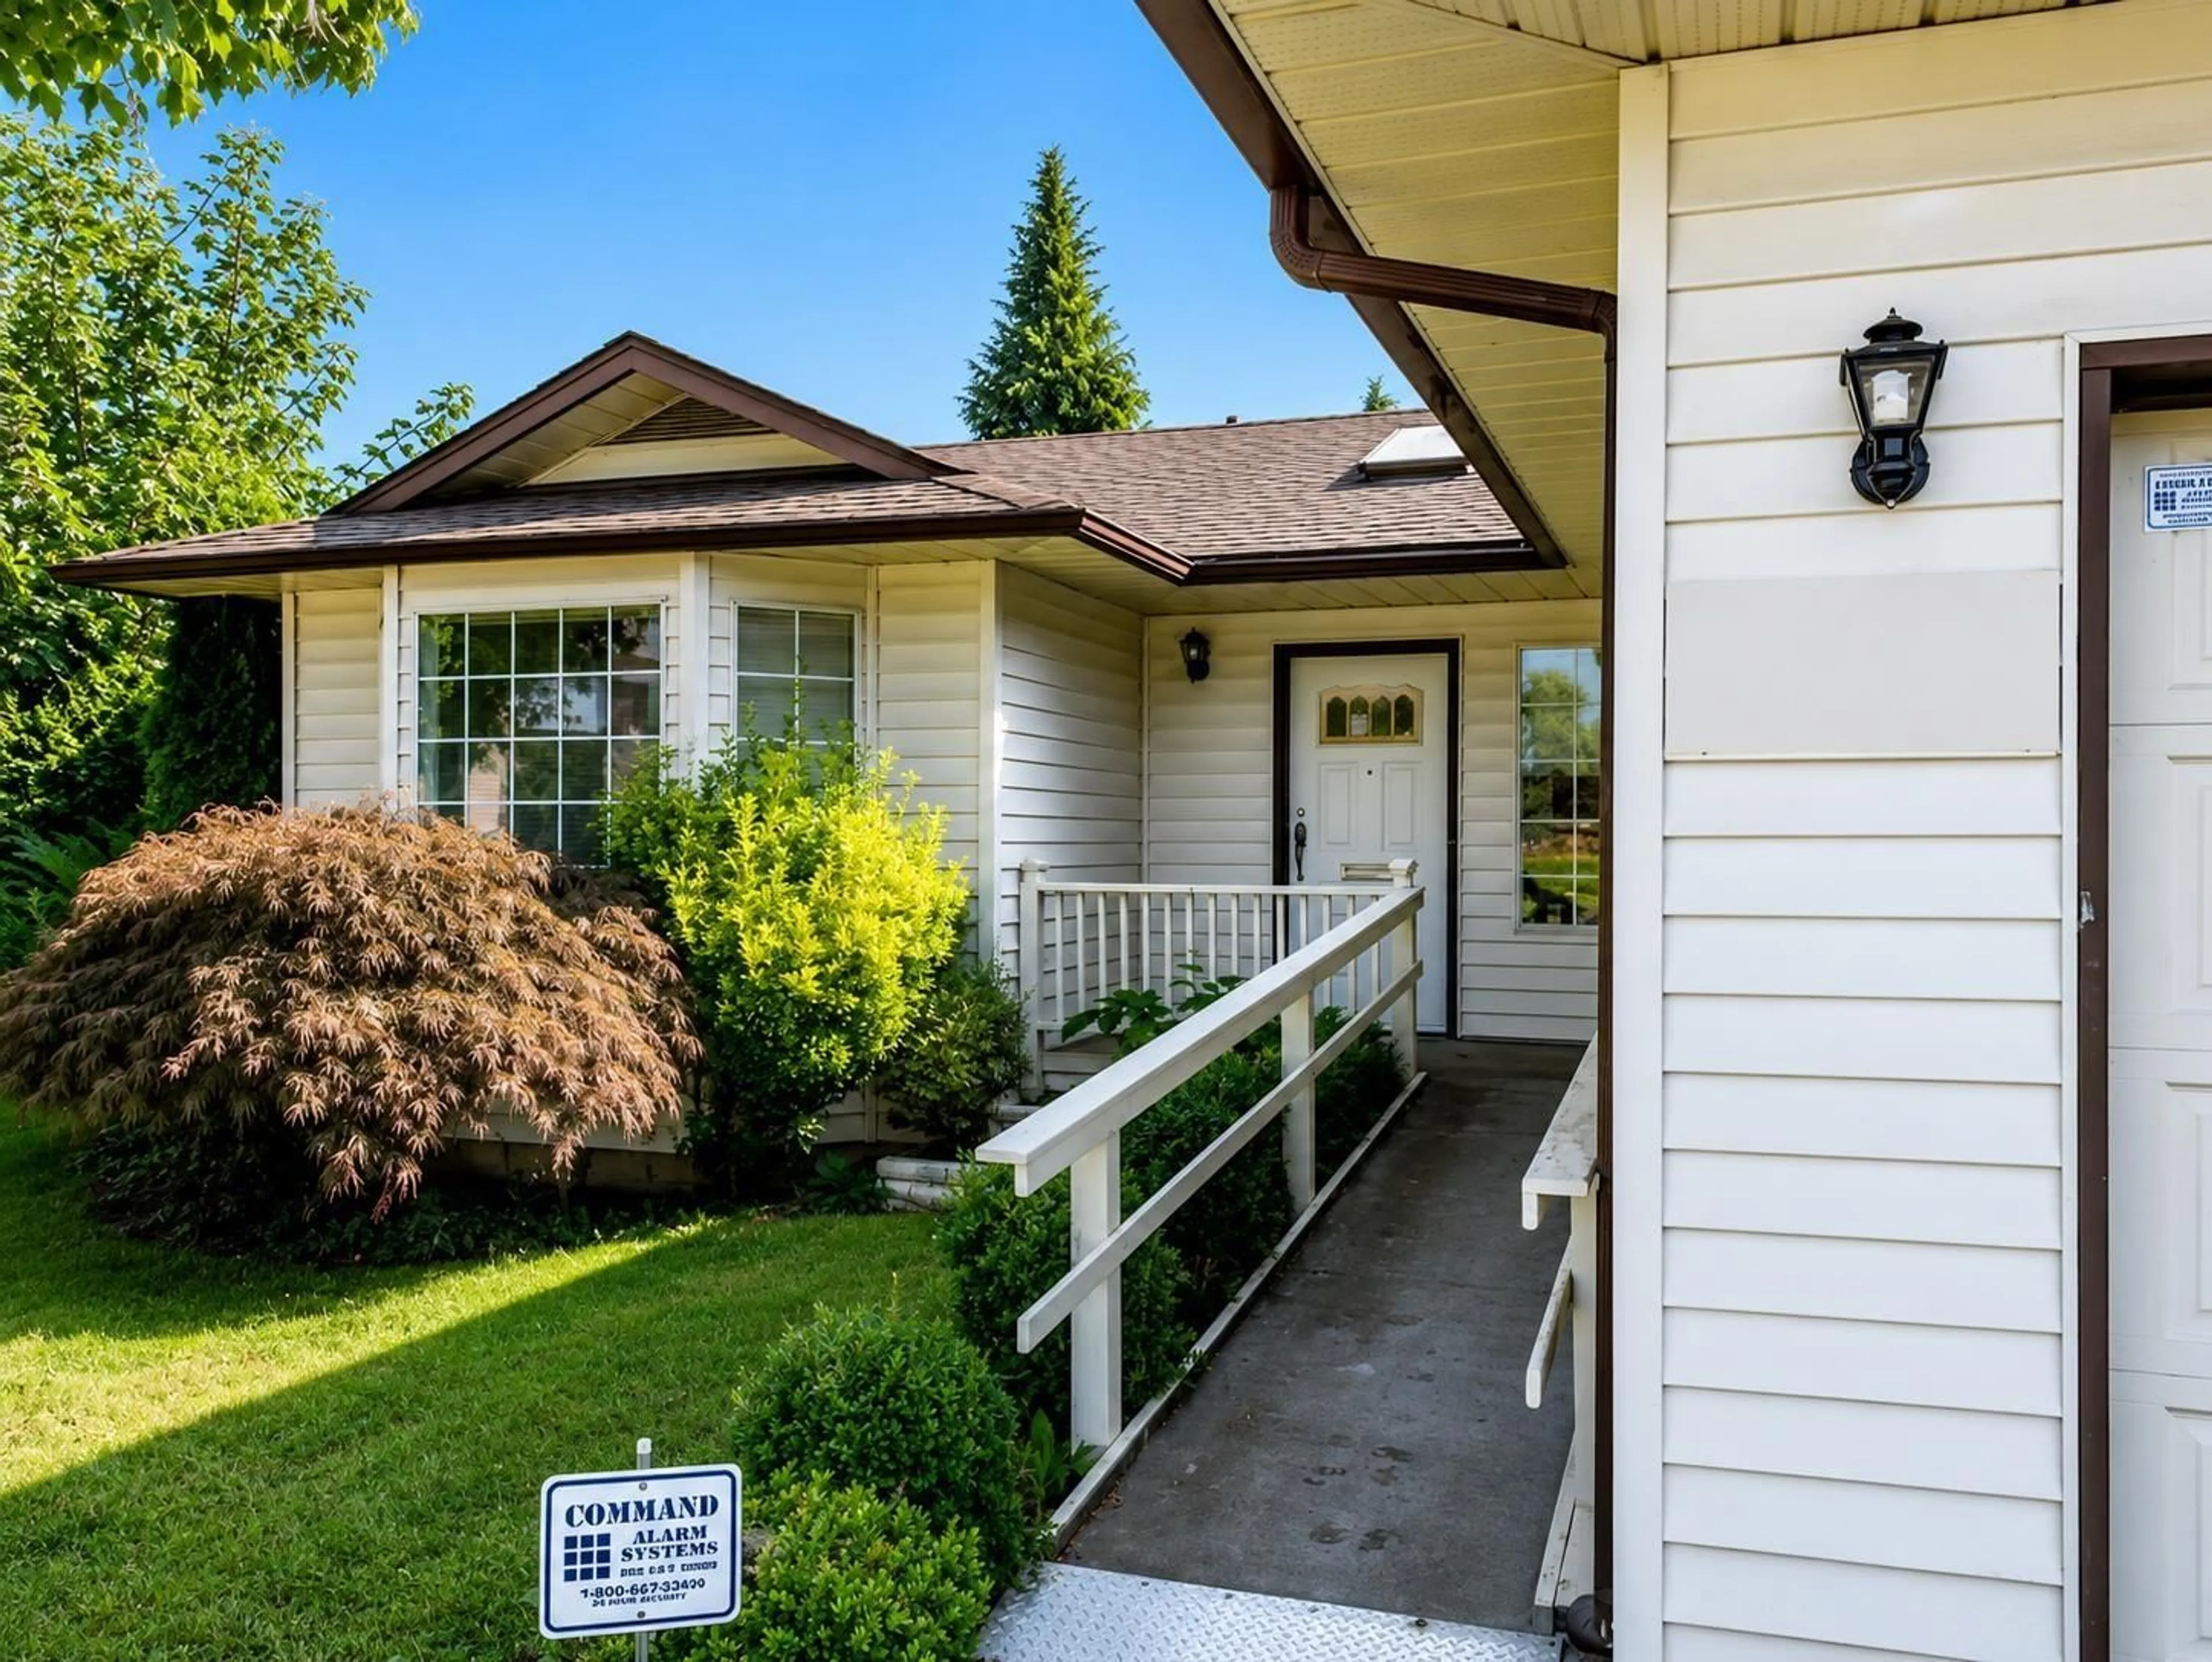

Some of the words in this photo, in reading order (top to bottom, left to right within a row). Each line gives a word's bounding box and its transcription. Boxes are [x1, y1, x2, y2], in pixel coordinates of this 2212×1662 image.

[565, 1494, 719, 1528] COMMAND
[632, 1525, 707, 1545] ALARM
[620, 1541, 718, 1562] SYSTEMS
